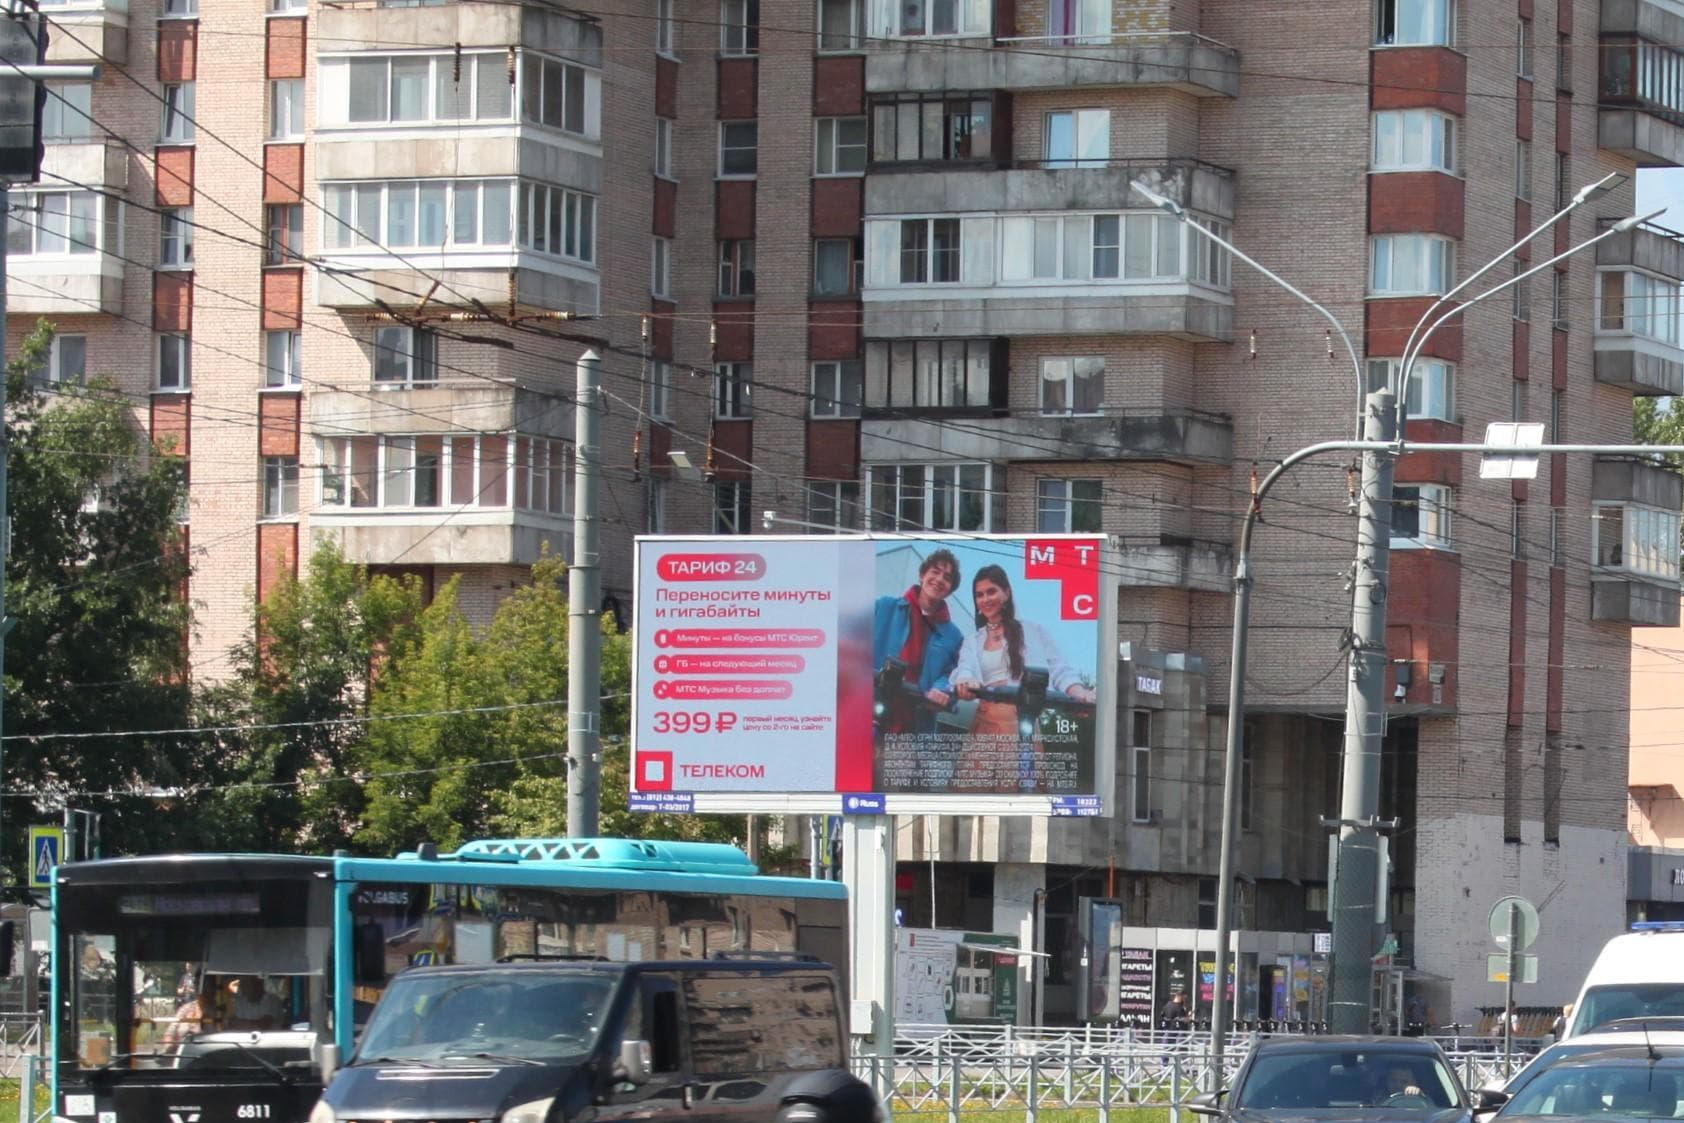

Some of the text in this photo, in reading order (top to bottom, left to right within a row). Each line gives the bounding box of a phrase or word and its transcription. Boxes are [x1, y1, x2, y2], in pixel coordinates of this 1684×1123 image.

[667, 560, 757, 574] ТАРИФ 24
[655, 588, 831, 604] Переносите минуты
[655, 604, 761, 618] и гигабайты
[768, 634, 788, 642] МТС
[676, 660, 688, 668] ГБ
[1137, 676, 1162, 695] ТАБАК
[653, 711, 737, 734] 399 ₽
[1055, 719, 1078, 733] 18+
[680, 764, 765, 778] ТЕЛЕКОМ
[237, 1104, 270, 1118] 6811
